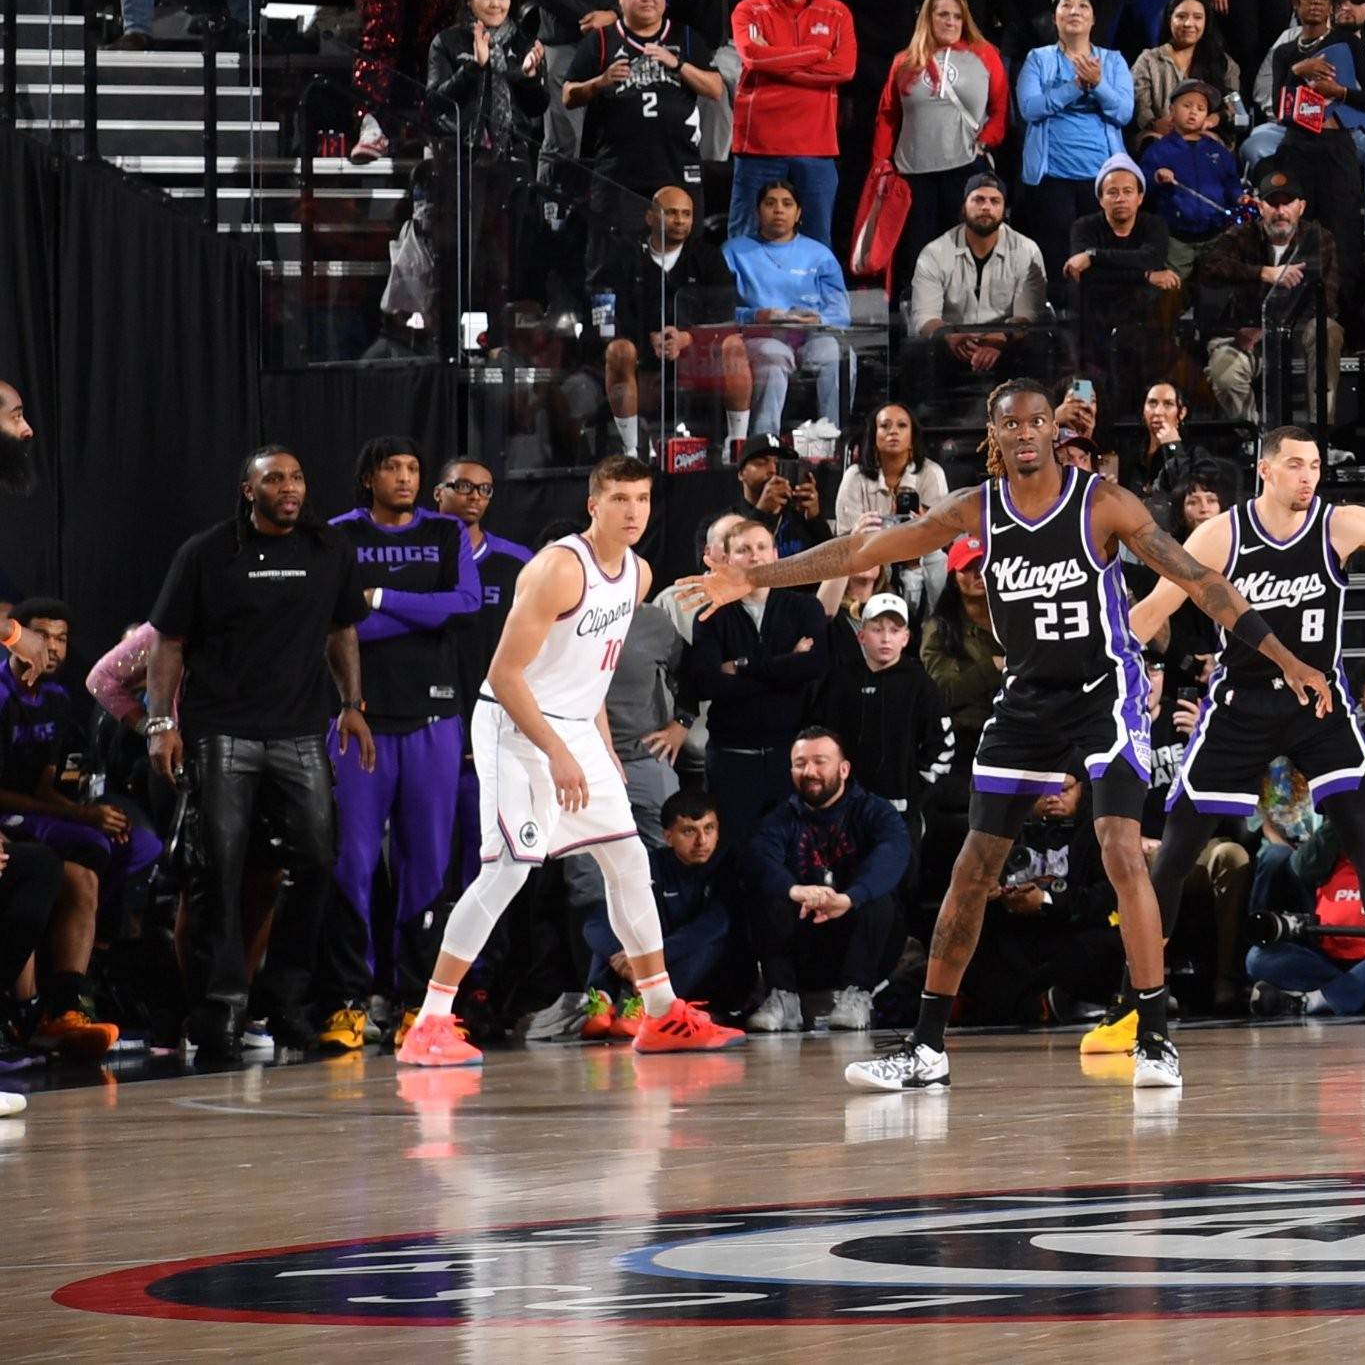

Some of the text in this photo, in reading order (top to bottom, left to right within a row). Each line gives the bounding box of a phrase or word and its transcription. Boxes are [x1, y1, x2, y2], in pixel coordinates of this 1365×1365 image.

[642, 91, 658, 119] 2
[356, 545, 440, 564] KINGS
[991, 556, 1088, 603] Kings
[1237, 570, 1327, 612] Kings
[576, 600, 633, 638] Clippers
[1033, 600, 1090, 642] 23
[1300, 607, 1326, 643] 8
[600, 639, 623, 673] 10
